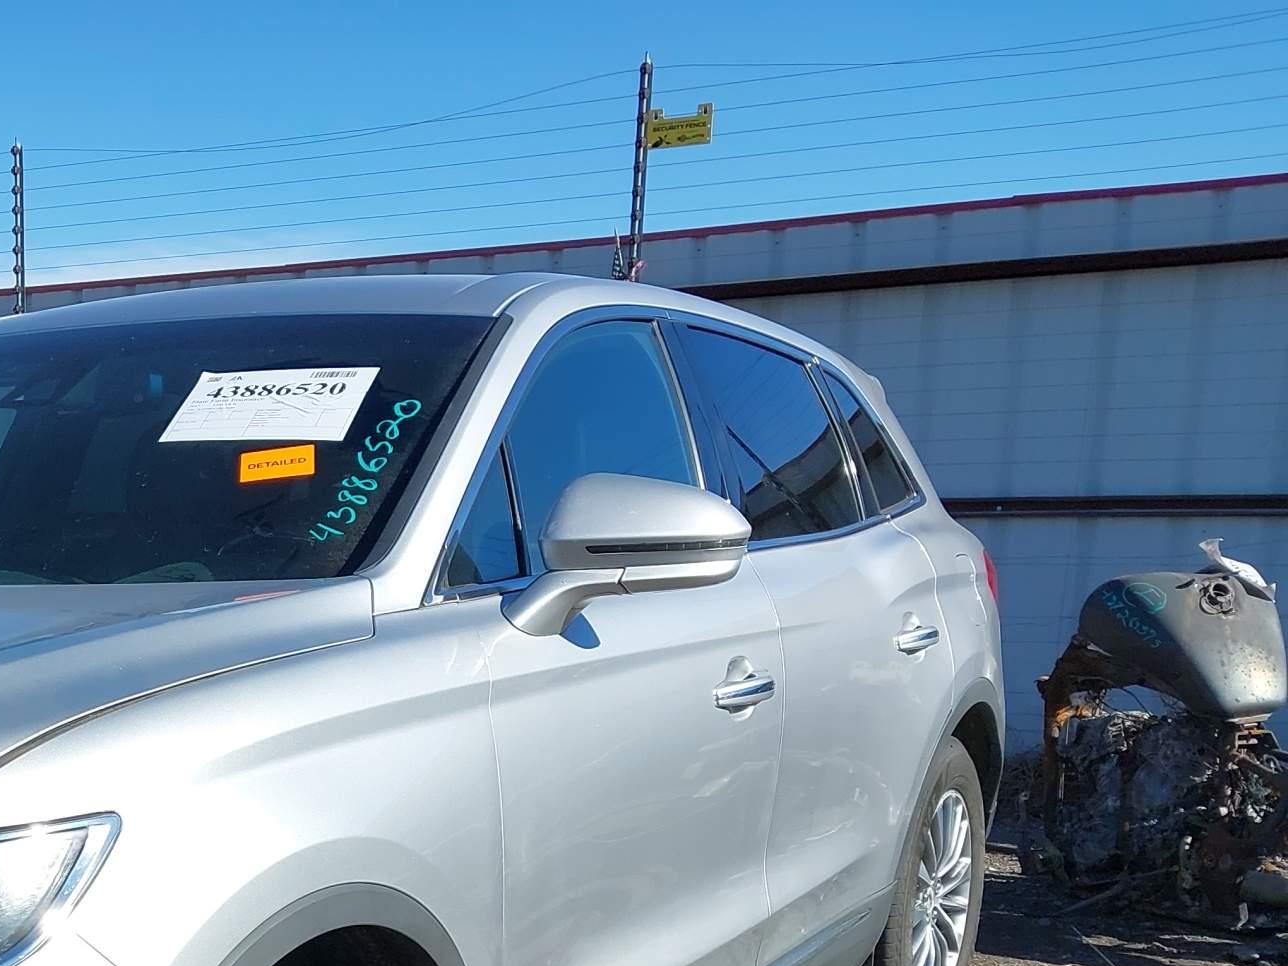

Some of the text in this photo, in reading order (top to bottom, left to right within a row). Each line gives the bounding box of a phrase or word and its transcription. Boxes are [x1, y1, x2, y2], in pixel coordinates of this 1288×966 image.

[206, 382, 347, 399] 43886520
[247, 457, 307, 470] DETAILED
[309, 399, 422, 541] 43886520
